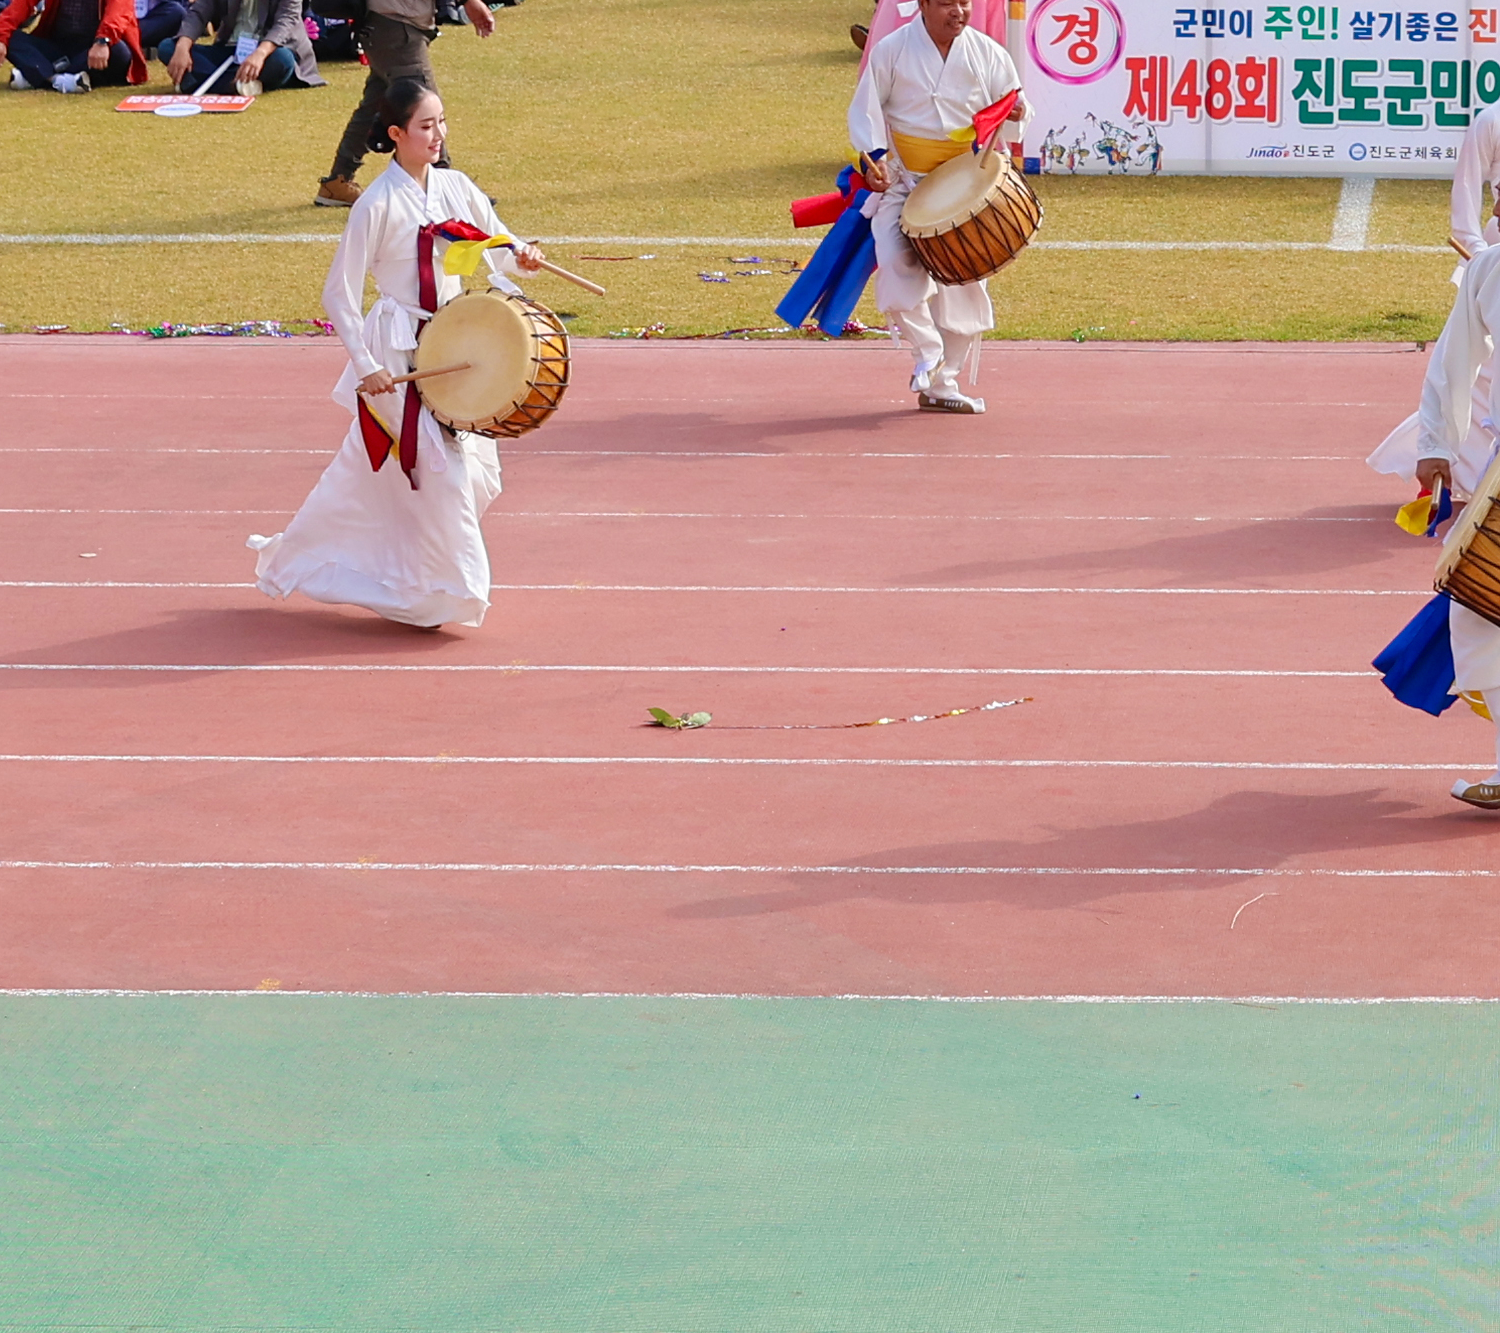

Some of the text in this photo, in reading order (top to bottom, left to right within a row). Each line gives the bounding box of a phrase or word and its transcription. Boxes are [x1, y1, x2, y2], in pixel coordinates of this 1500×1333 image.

[1050, 7, 1099, 65] 경
[1173, 9, 1252, 38] 군민이
[1264, 5, 1338, 40] 주인!
[1350, 10, 1458, 42] 살기좋은
[1123, 55, 1278, 123] 제48회
[1246, 145, 1336, 158] Jindo 진도군
[1369, 146, 1457, 160] 진도군체육회
